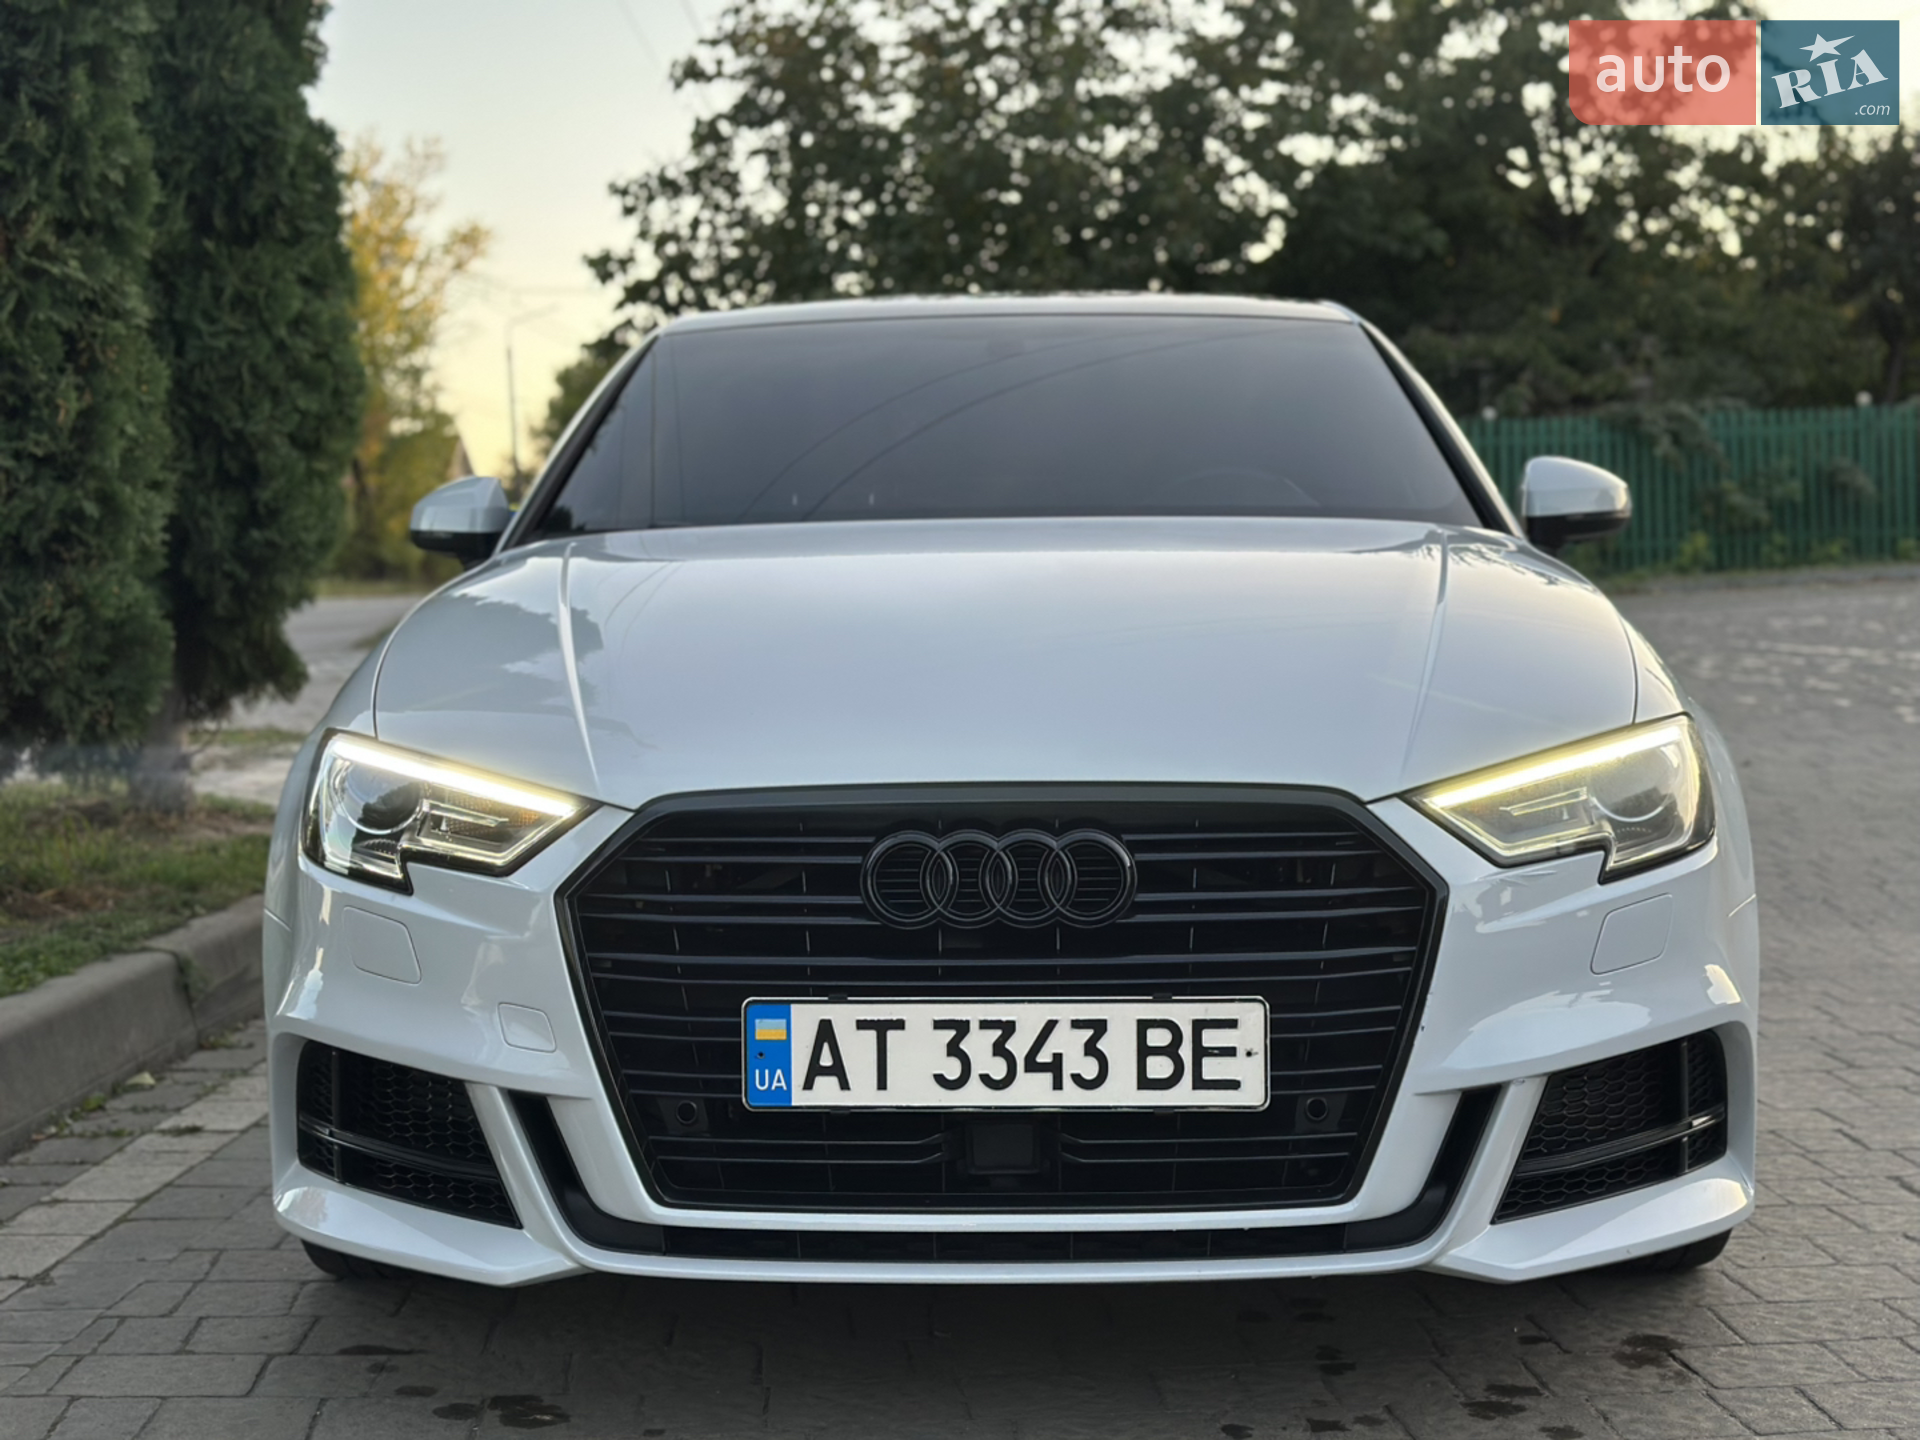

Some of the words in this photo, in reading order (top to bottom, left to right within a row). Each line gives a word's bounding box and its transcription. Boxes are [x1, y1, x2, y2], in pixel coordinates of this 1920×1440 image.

[802, 1018, 906, 1091] AT
[932, 1018, 1110, 1091] 3343
[1136, 1018, 1242, 1091] BE
[754, 1069, 788, 1092] UA
